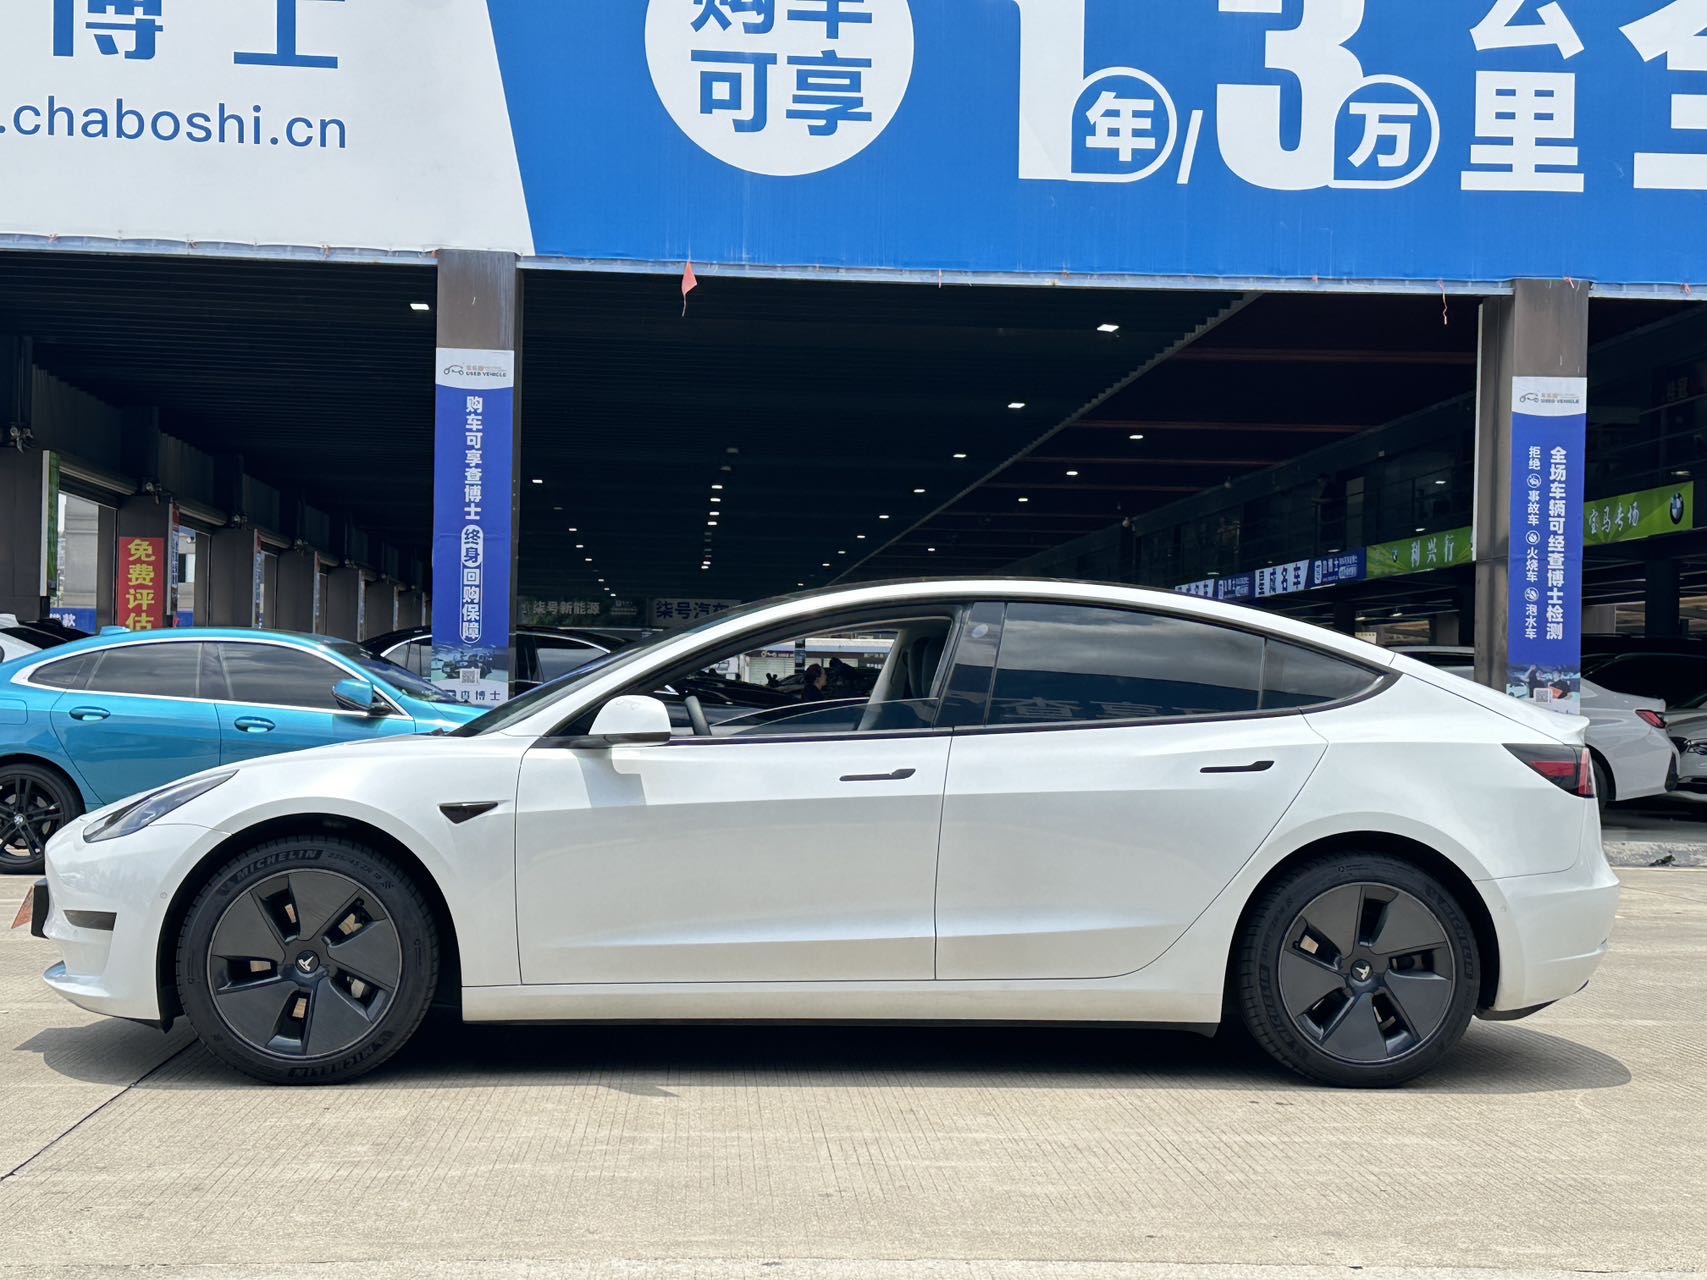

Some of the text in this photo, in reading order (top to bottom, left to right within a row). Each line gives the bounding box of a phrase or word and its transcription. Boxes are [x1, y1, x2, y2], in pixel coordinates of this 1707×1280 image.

[690, 49, 872, 137] 可享
[126, 539, 156, 629] 免费评估
[236, 850, 320, 883] MICHELIN
